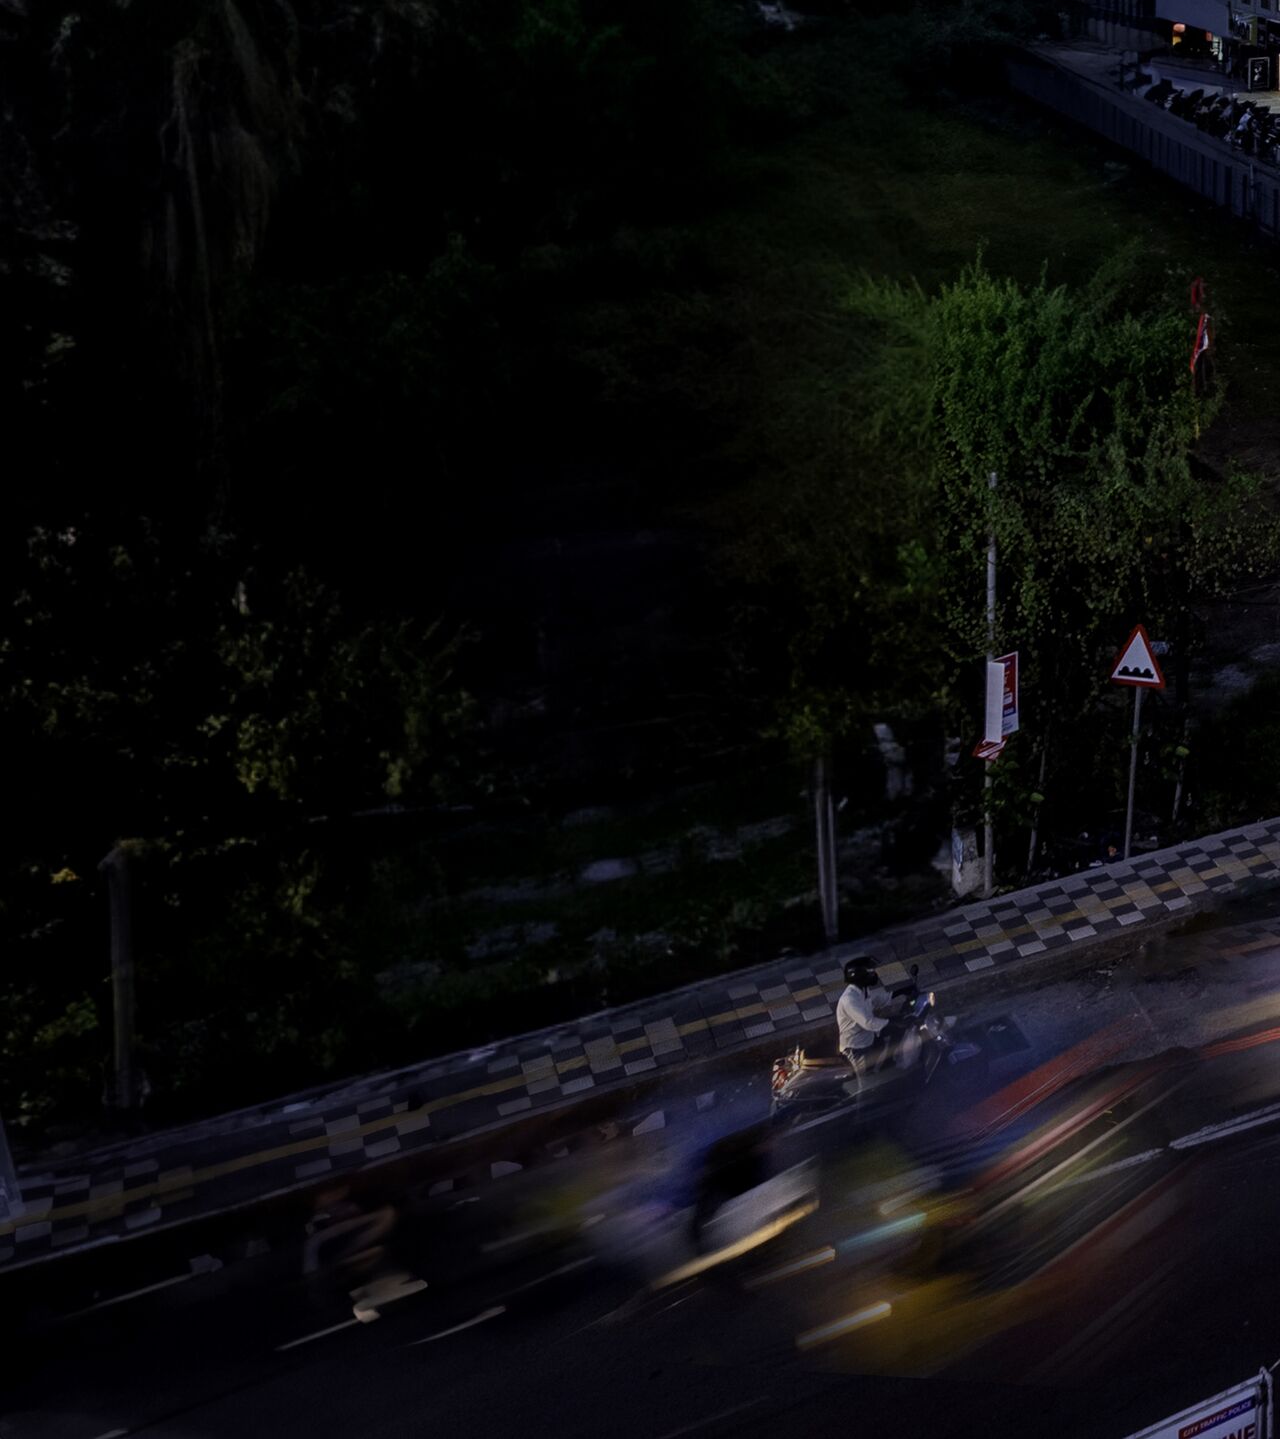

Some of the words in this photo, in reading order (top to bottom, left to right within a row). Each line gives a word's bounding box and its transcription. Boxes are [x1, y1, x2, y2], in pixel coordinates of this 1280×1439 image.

[1183, 1426, 1199, 1438] CITY
[1200, 1412, 1227, 1431] TRAFFIC
[1228, 1400, 1253, 1419] POLICE
